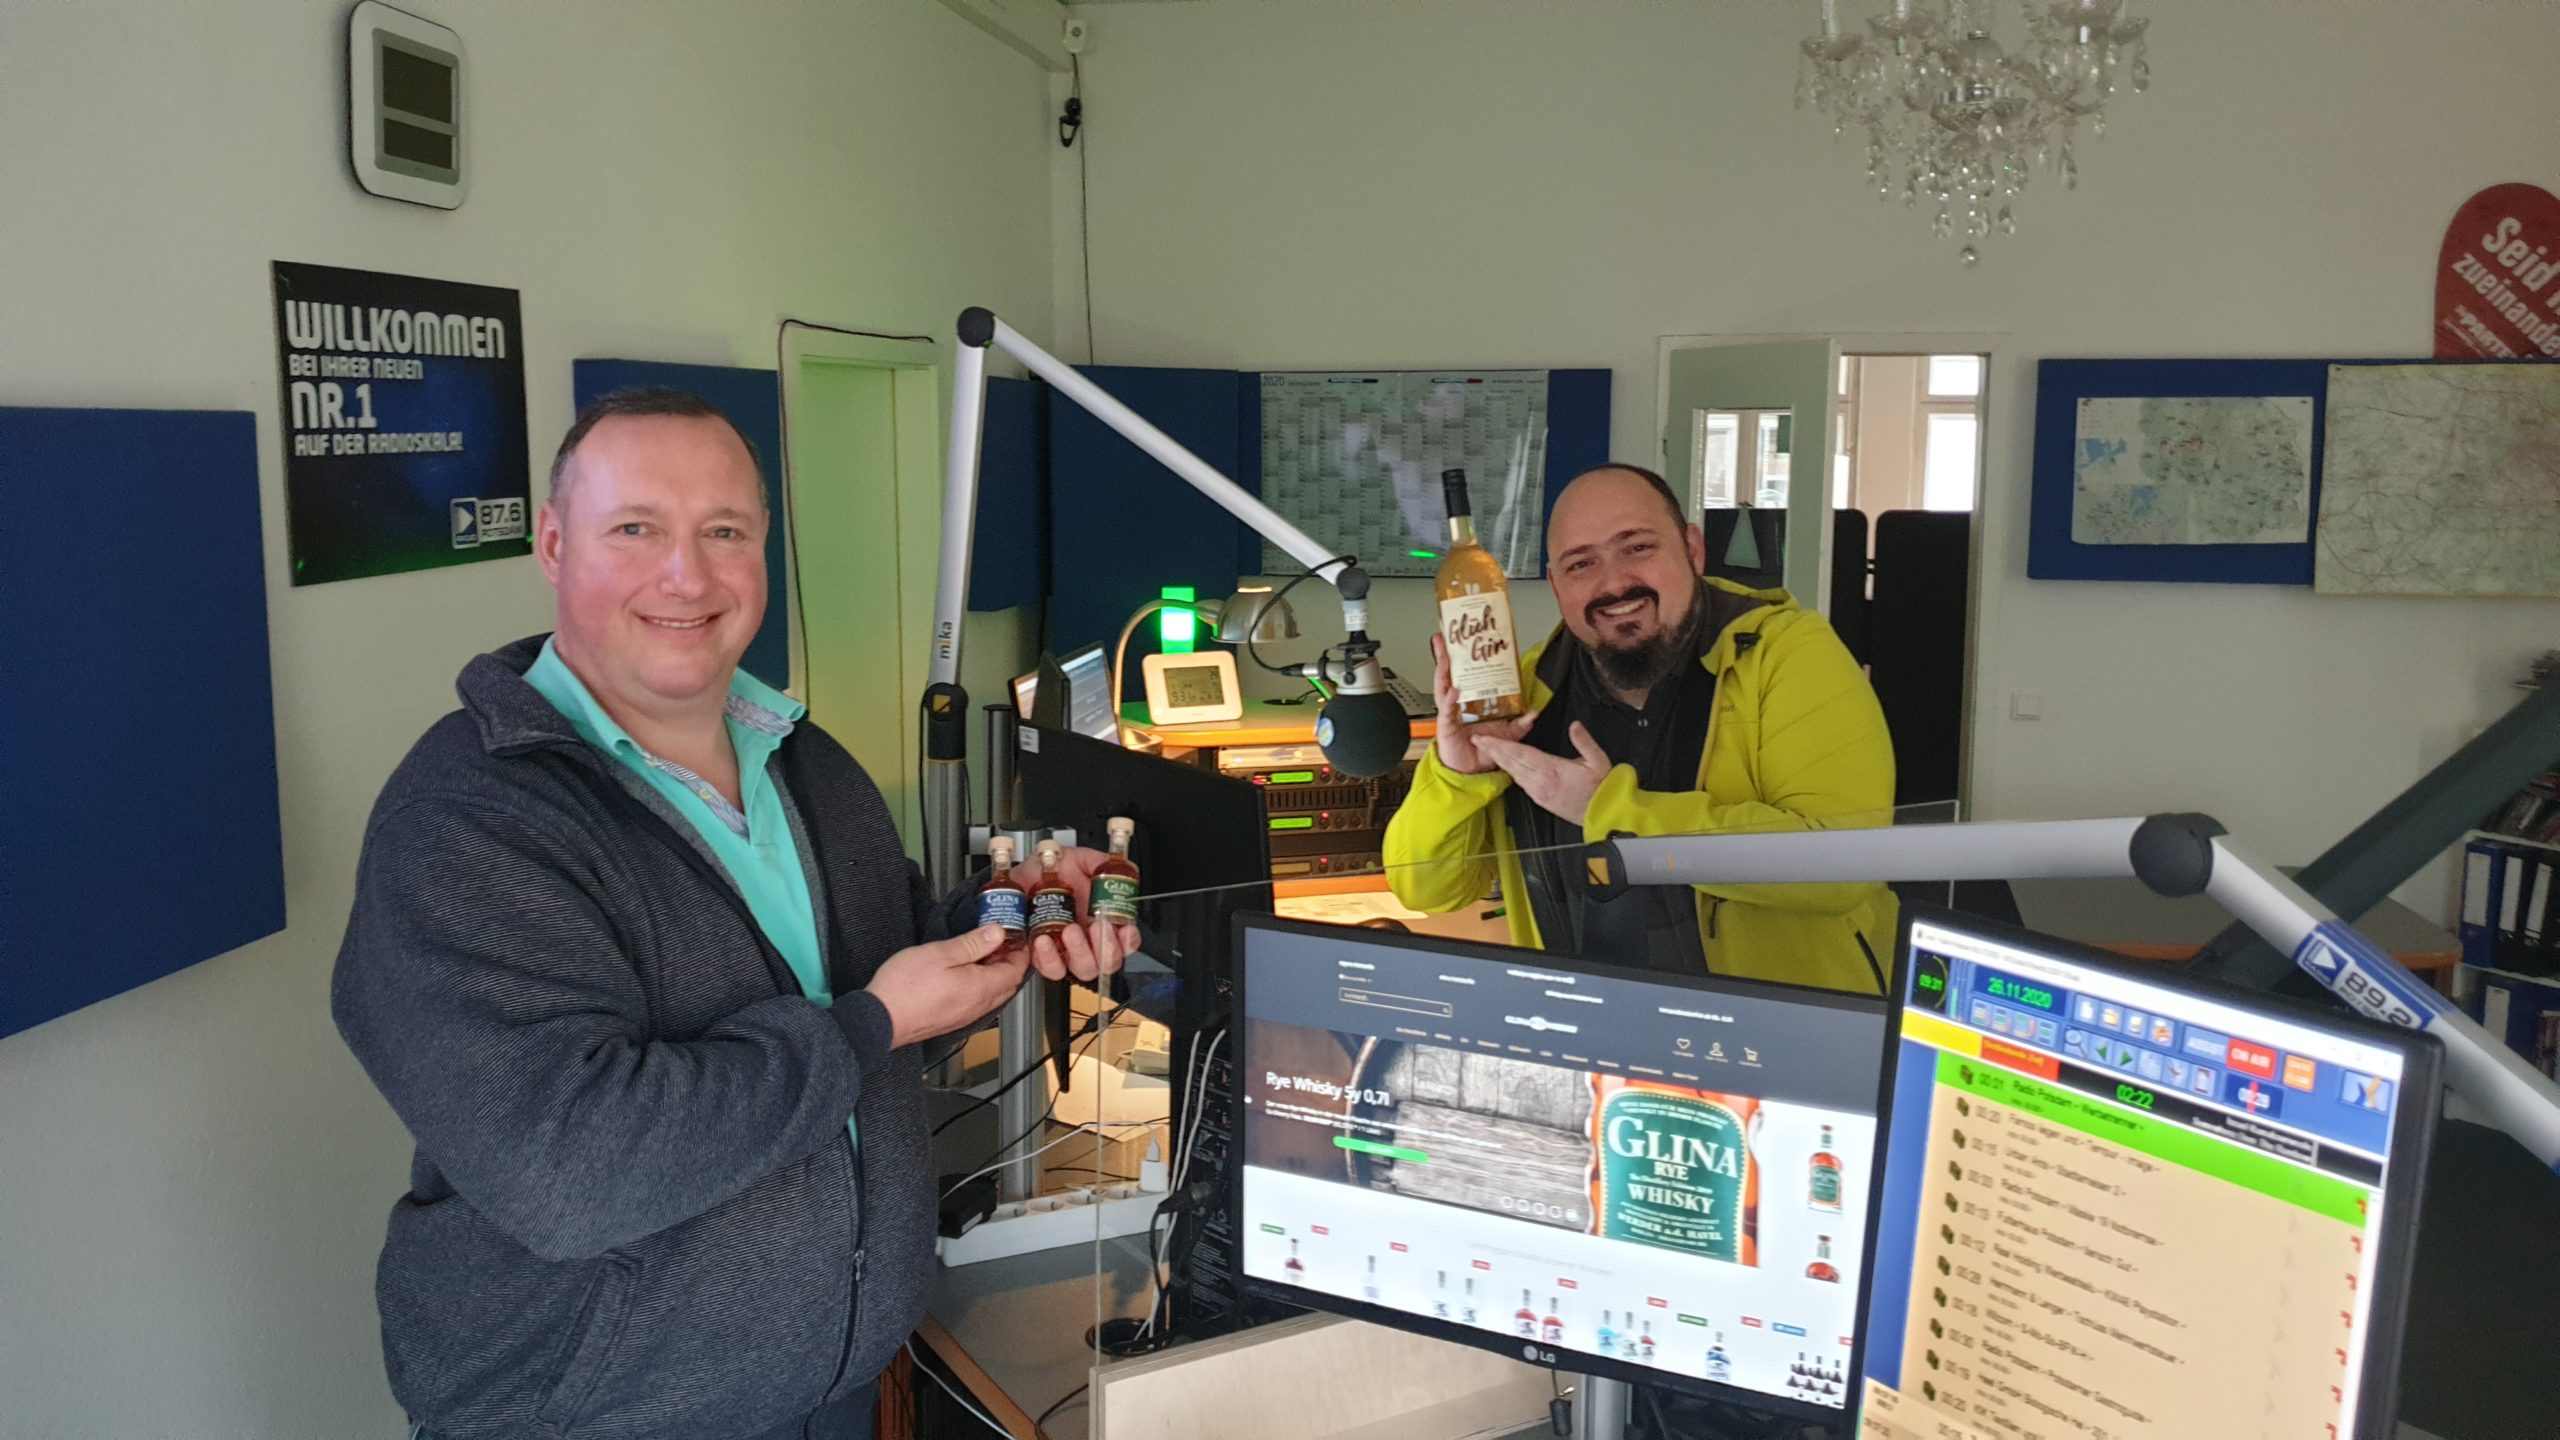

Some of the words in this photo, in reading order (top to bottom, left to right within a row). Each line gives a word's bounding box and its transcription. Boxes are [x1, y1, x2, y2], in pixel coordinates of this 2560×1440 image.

[2481, 217, 2560, 293] Seid
[2451, 252, 2560, 356] zueinande
[285, 300, 505, 358] WILLKOMMEN
[289, 354, 318, 377] BEI
[321, 355, 371, 379] IHRER
[373, 358, 424, 380] NEUEN
[291, 381, 377, 429] NR.1
[295, 434, 330, 456] AUF
[333, 433, 365, 454] DER
[481, 502, 521, 526] 87.6
[938, 621, 953, 660] mika
[1449, 604, 1496, 646] Glüh
[1471, 636, 1509, 662] Gin
[2345, 971, 2412, 1025] 89.2
[1266, 1071, 1292, 1090] Rye
[1292, 1076, 1343, 1101] Whisky
[1607, 1115, 1739, 1179] GLINA
[1654, 1161, 1689, 1180] RYE
[1627, 1183, 1716, 1215] WHISKY
[1539, 1350, 1556, 1363] LG
